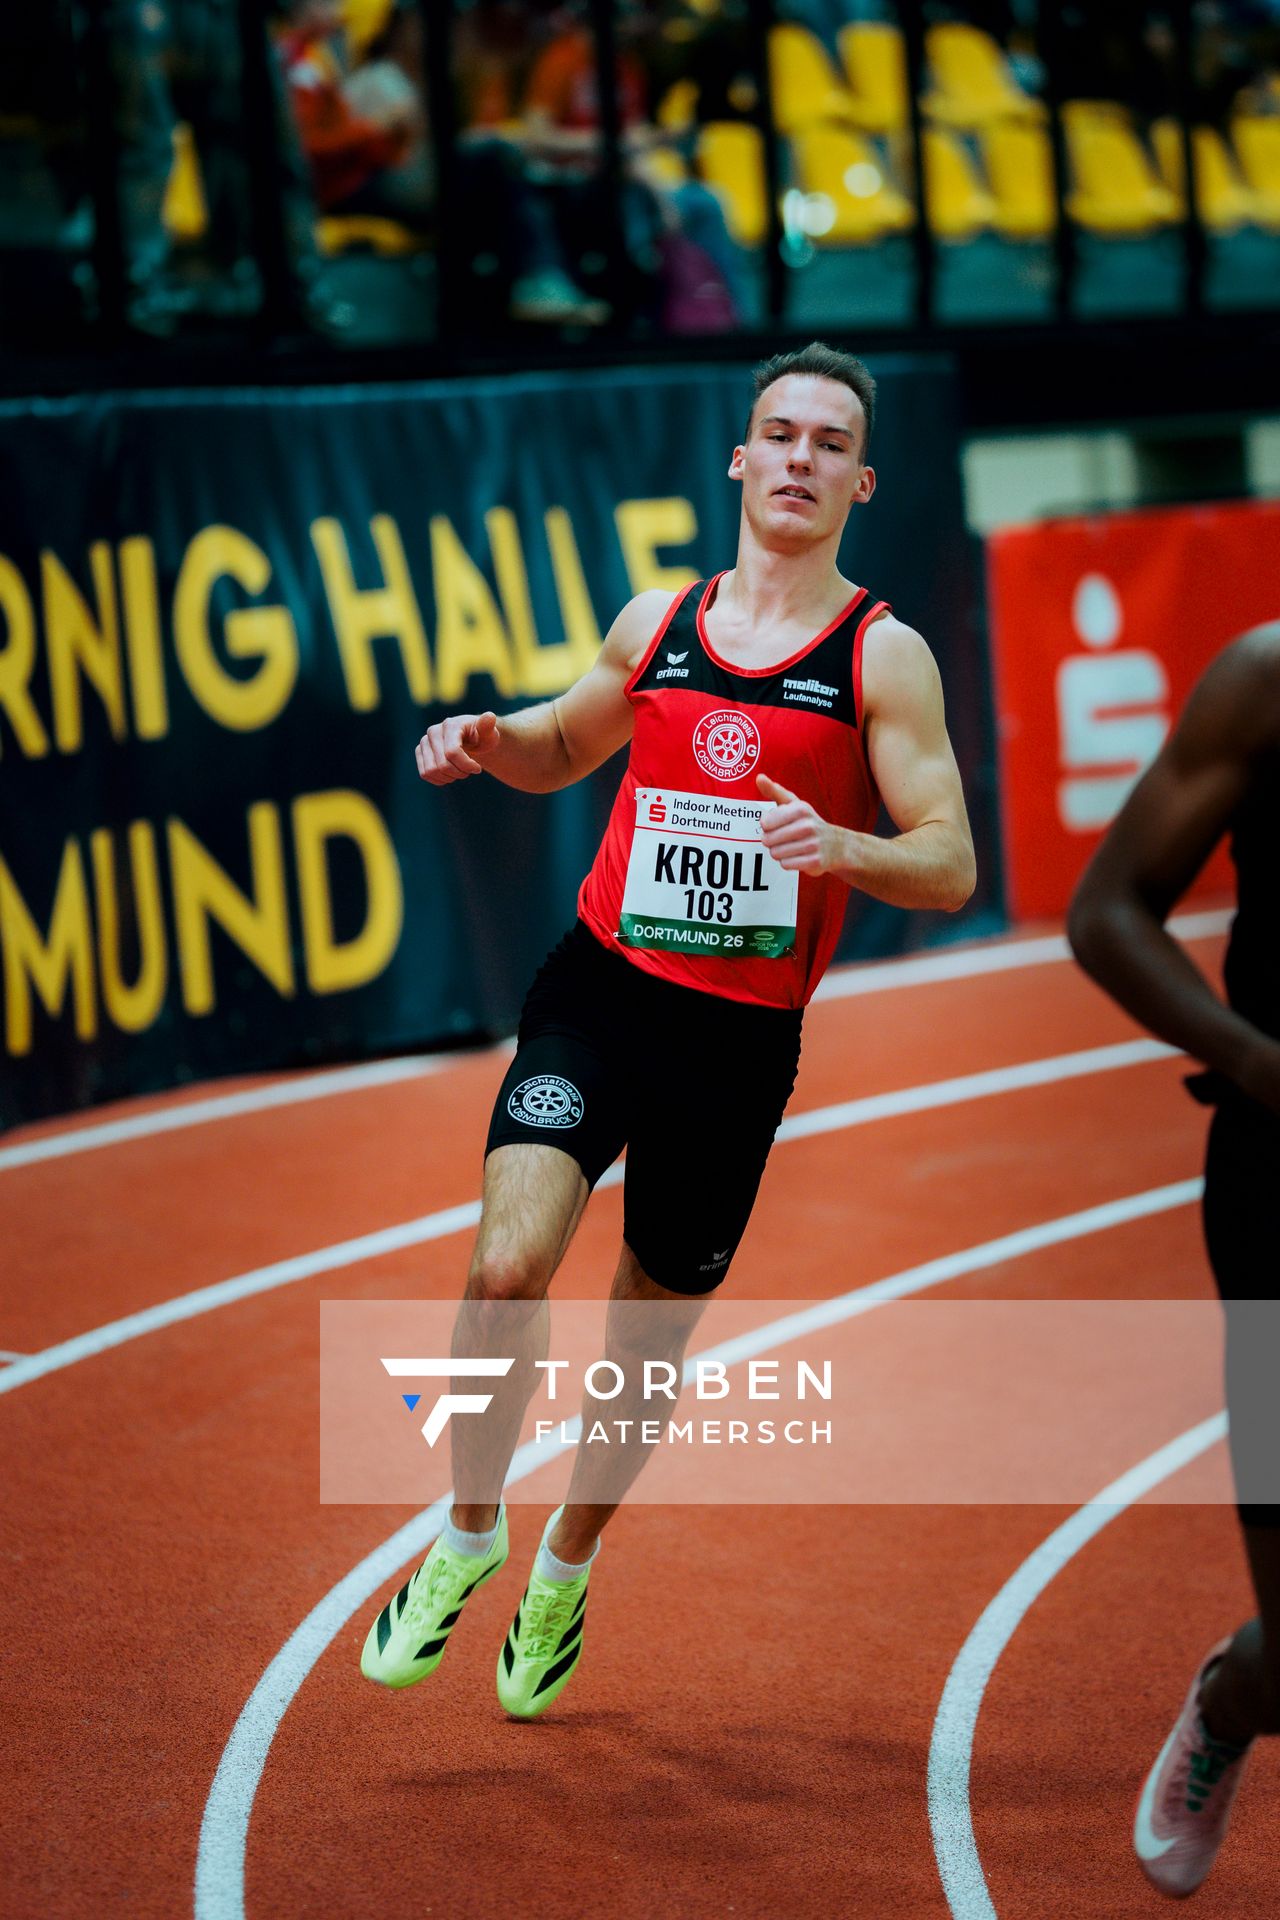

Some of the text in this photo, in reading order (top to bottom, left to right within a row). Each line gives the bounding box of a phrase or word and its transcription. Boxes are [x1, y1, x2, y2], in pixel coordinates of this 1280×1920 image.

[656, 667, 690, 680] erima
[782, 678, 840, 697] molitor
[783, 691, 833, 709] Laufanalyse
[697, 749, 750, 778] OSNABRÜCK
[673, 798, 763, 822] Indoor Meeting
[671, 814, 731, 833] Dortmund
[654, 843, 769, 892] KROLL
[684, 889, 734, 924] 103
[633, 924, 744, 948] DORTMUND 26
